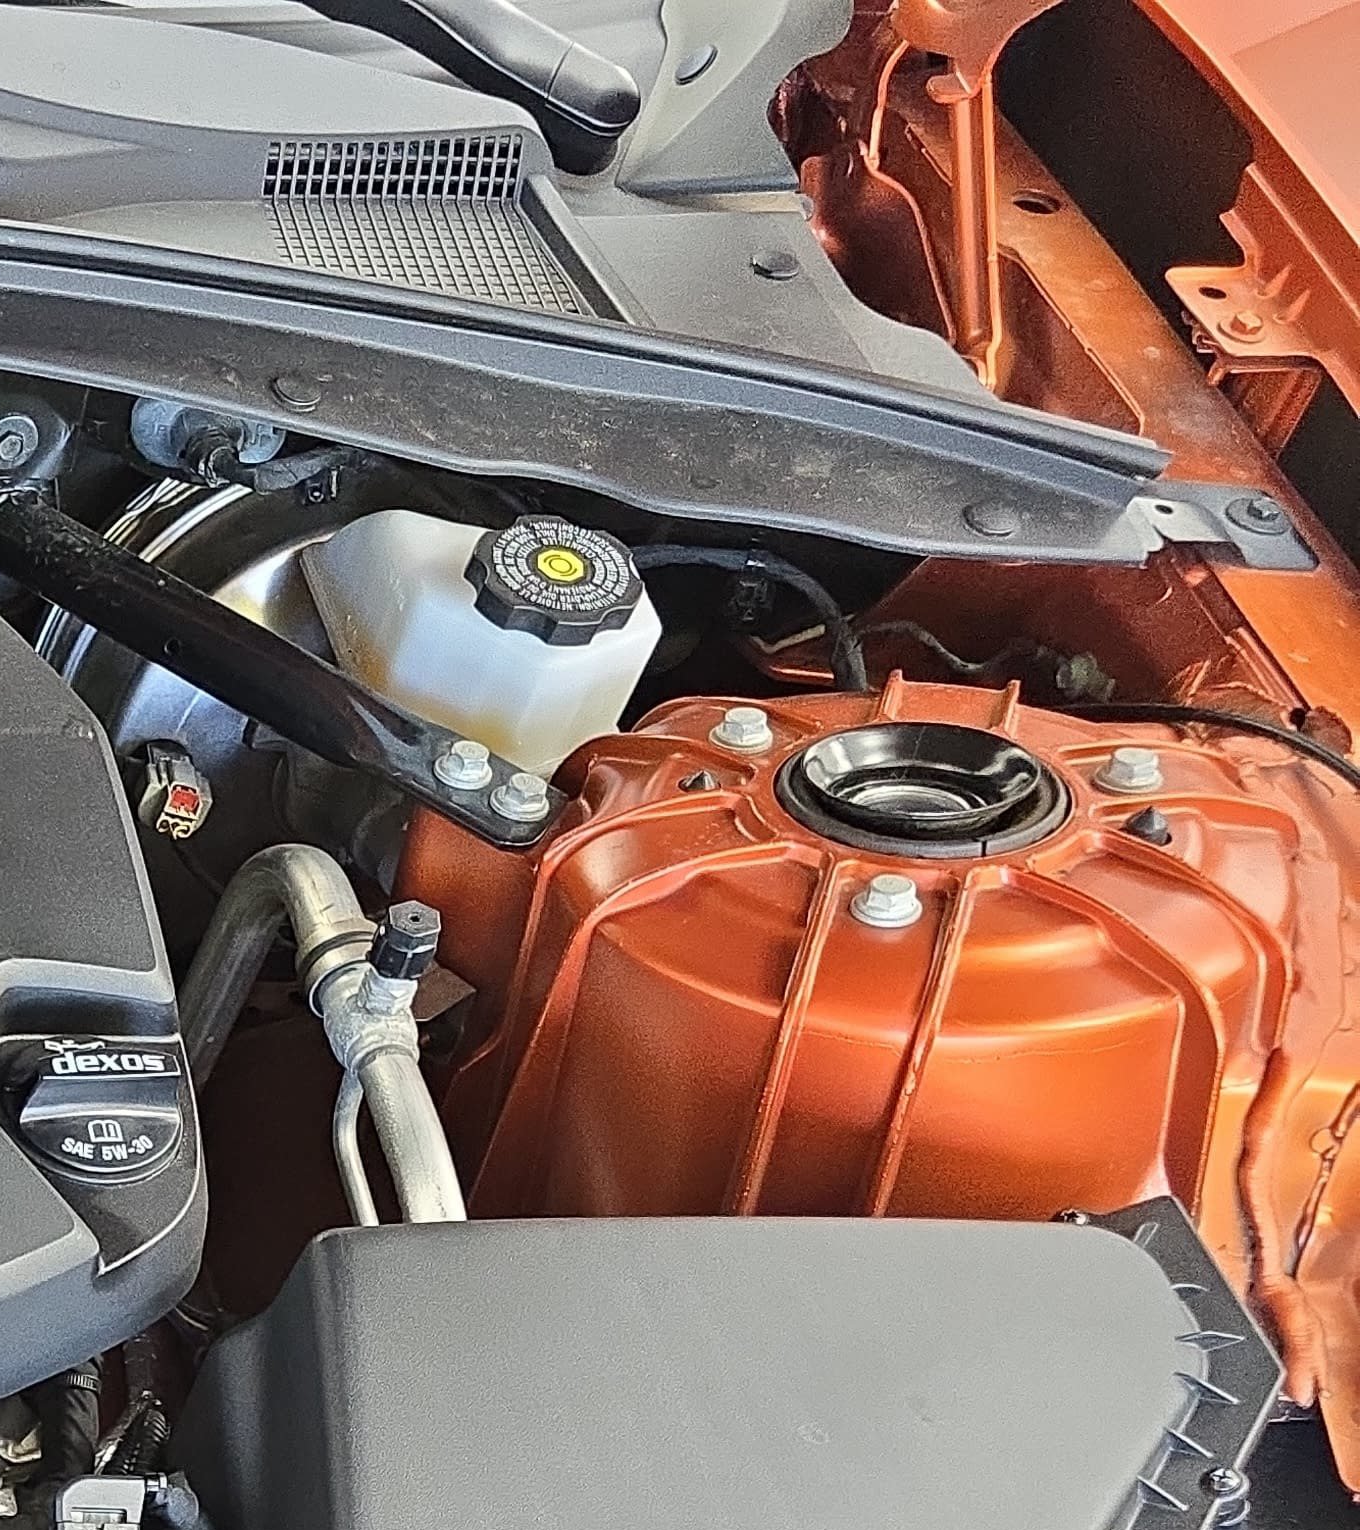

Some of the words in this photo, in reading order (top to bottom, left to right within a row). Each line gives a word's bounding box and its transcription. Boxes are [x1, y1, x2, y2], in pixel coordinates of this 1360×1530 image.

[50, 1053, 166, 1076] dexos
[60, 1136, 95, 1160] SAE
[101, 1135, 154, 1161] 5W-30
